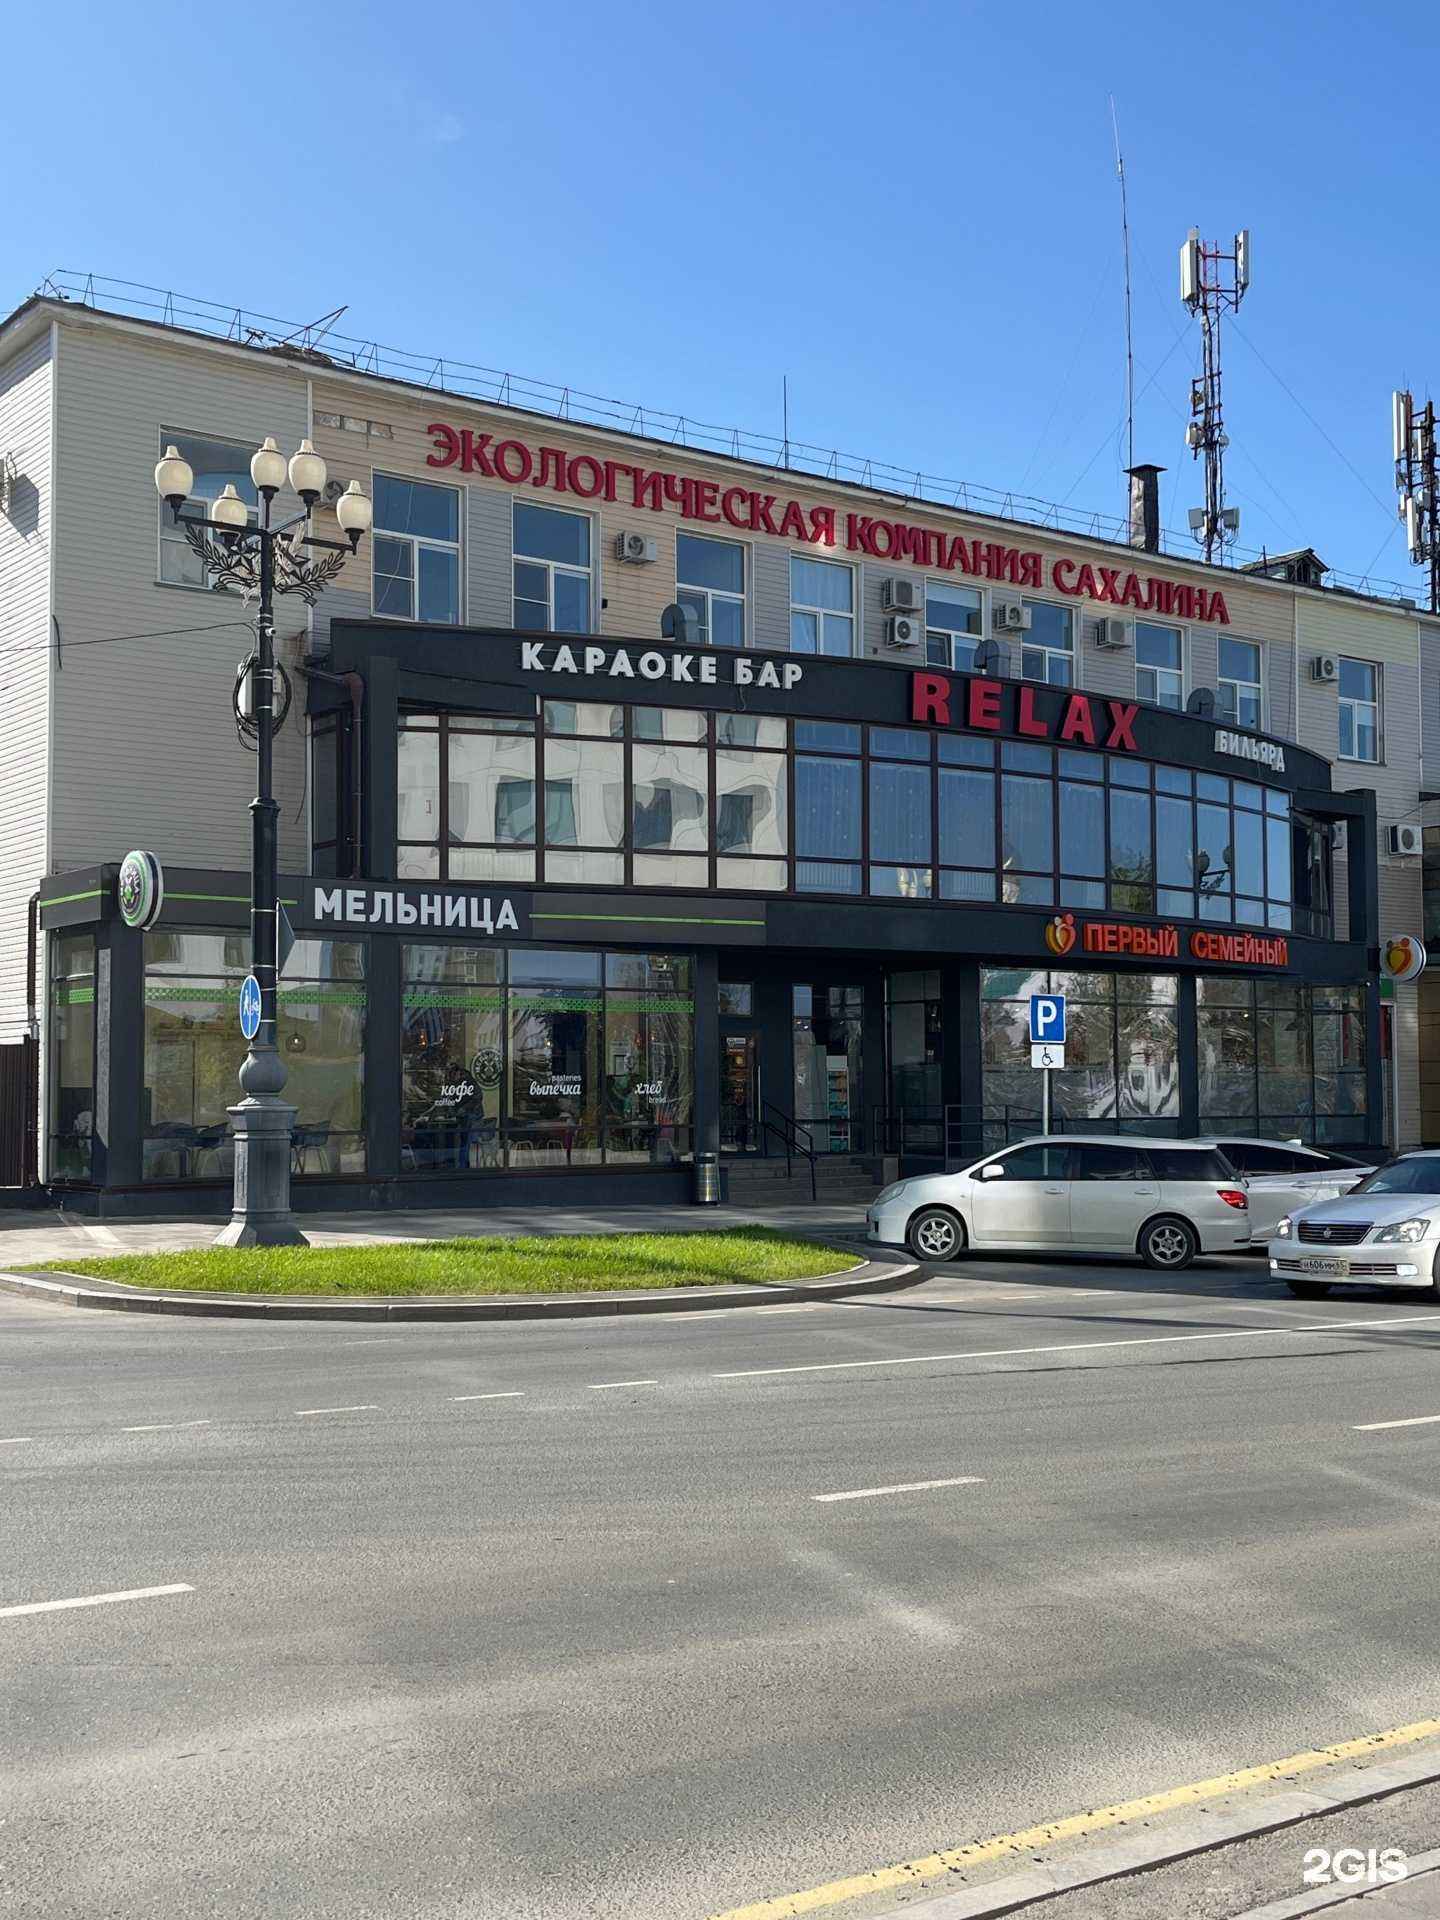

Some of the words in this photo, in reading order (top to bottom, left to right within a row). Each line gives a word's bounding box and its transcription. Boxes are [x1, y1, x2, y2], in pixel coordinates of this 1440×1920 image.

[426, 423, 836, 547] ЭКОЛОГИЧЕСКАЯ
[847, 513, 1042, 588] КОМПАНИЯ
[1052, 559, 1231, 625] САХАЛИНА
[521, 641, 717, 684] КАРАОКЕ
[733, 657, 803, 690] БАР
[912, 672, 1140, 751] RELAX
[1214, 730, 1285, 773] БИЛЬЯРД
[314, 887, 519, 935] МЕЛЬНИЦА
[1083, 921, 1179, 958] ПЕРВЫЙ
[1190, 931, 1289, 967] СЕМЕЙНЫЙ
[440, 1080, 475, 1103] кофе
[529, 1081, 582, 1096] выпечка
[634, 1080, 663, 1095] хлеб
